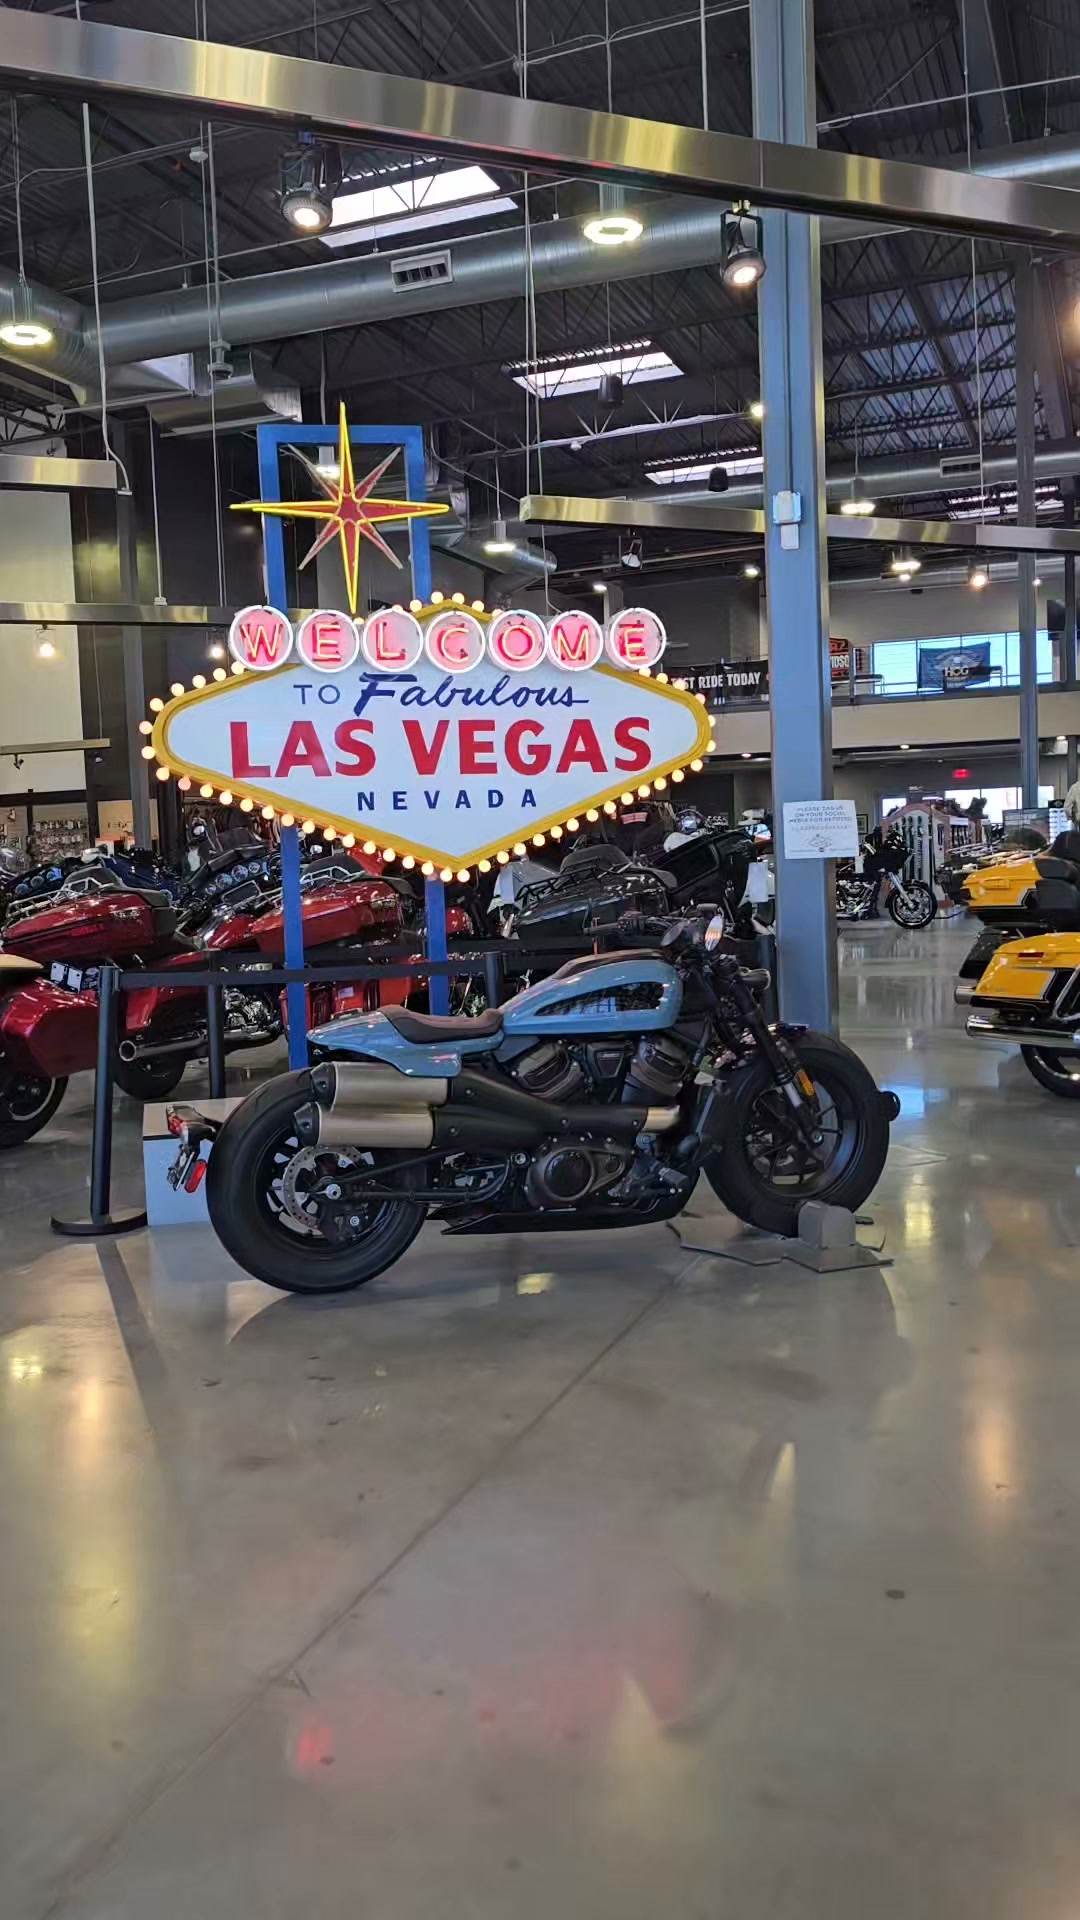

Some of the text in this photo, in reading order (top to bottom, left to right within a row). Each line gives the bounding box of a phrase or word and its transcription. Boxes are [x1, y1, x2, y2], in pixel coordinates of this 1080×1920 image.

[237, 619, 651, 664] WELCOME
[293, 672, 589, 717] TO Fabulous
[698, 674, 724, 689] RIDE
[726, 671, 761, 687] TODAY
[230, 717, 652, 779] LAS VEGAS
[357, 788, 538, 811] NEVADA
